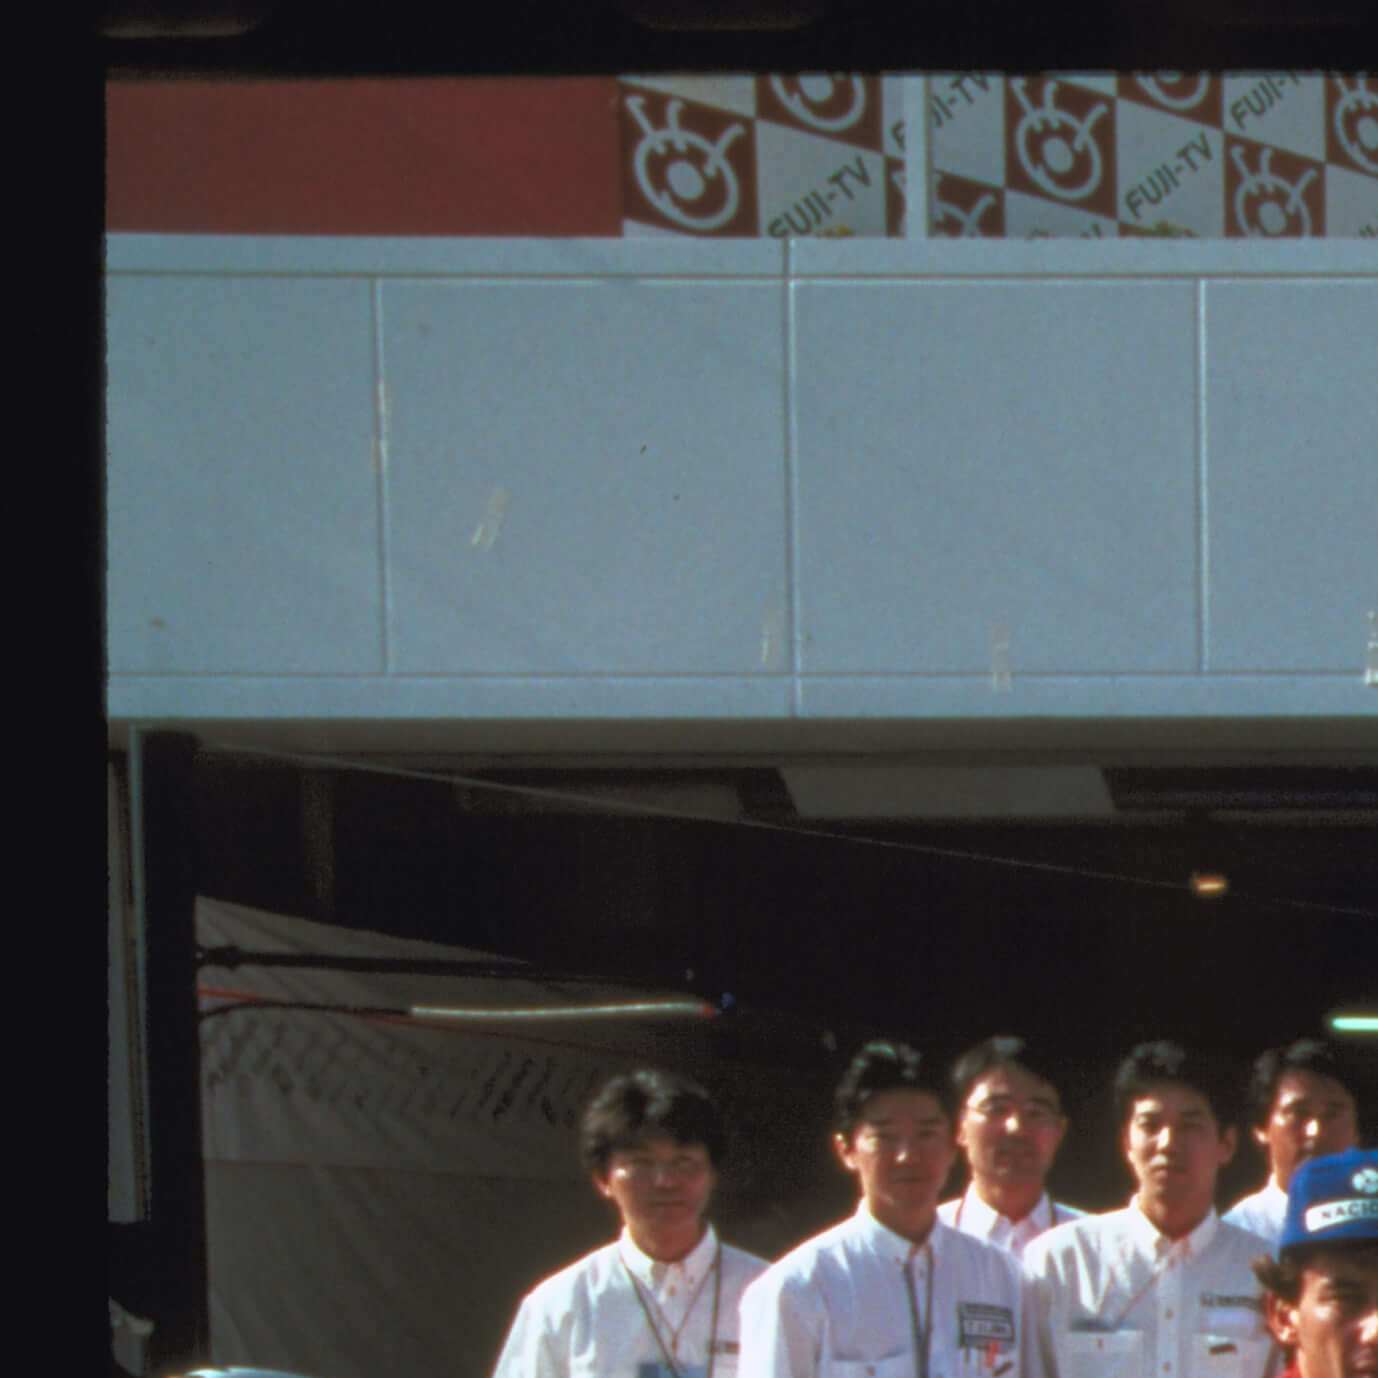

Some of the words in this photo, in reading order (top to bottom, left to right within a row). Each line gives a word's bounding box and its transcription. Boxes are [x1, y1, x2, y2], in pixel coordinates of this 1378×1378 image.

[1230, 72, 1303, 130] FUJI-T
[768, 156, 872, 238] FUJI-TV
[1125, 132, 1213, 219] FUJI-TV
